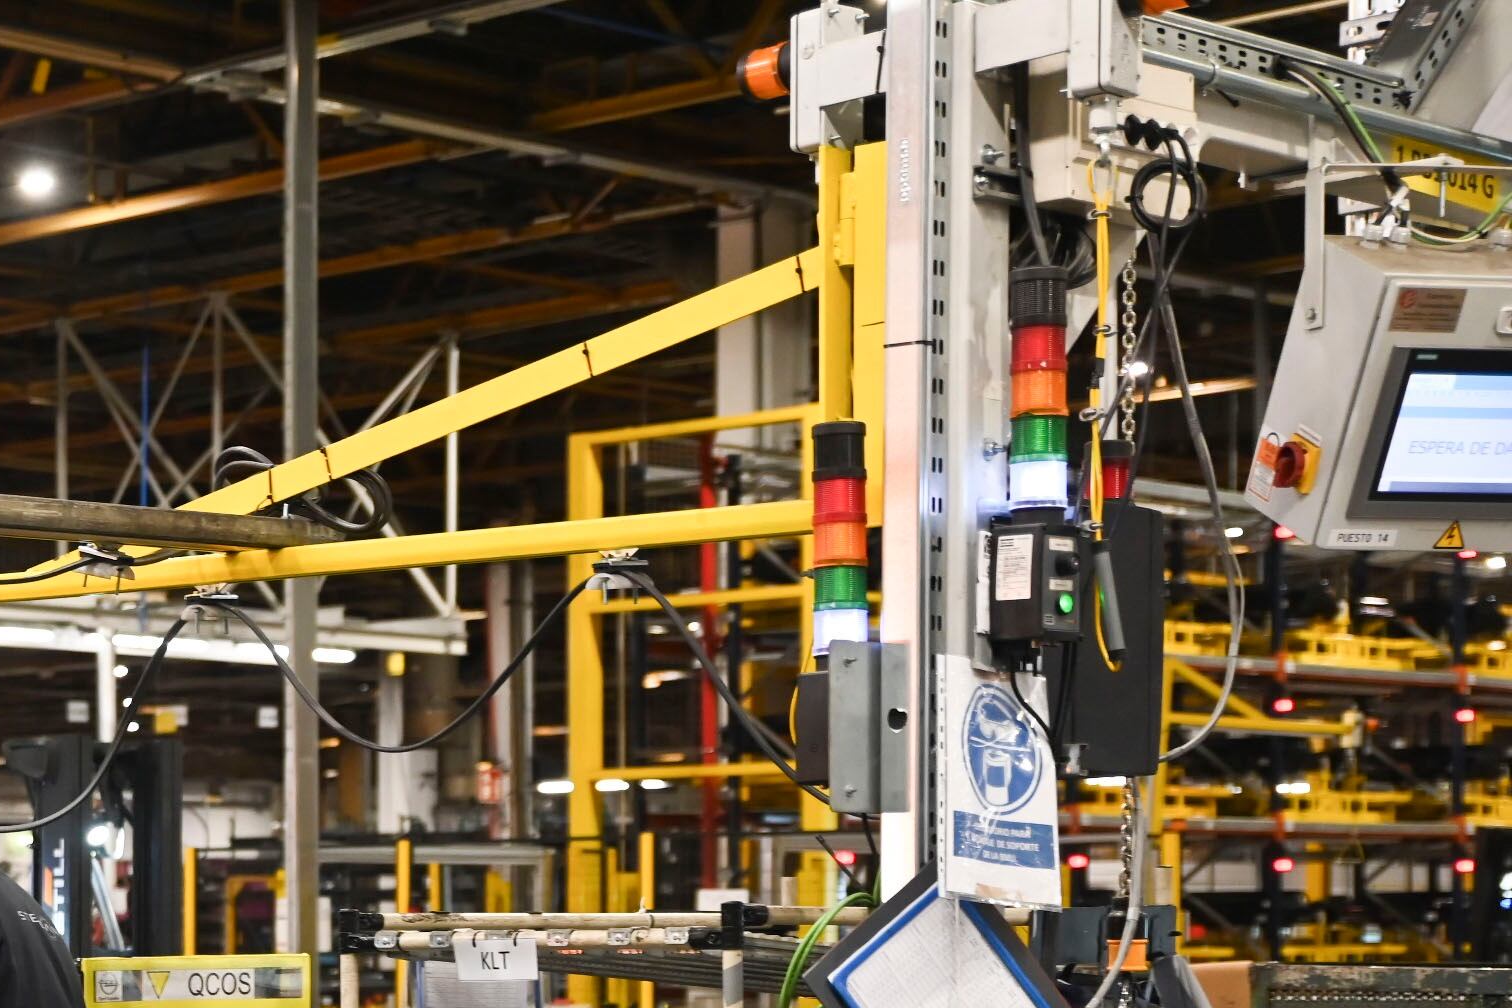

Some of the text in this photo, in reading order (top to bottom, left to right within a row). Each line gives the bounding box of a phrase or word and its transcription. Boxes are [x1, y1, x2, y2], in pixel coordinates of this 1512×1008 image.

[1483, 175, 1495, 199] G
[1408, 441, 1465, 455] ESPERA
[1470, 441, 1492, 455] DE
[1338, 533, 1390, 543] PUESTO 14
[480, 951, 510, 970] KLT
[188, 972, 251, 997] QCOS
